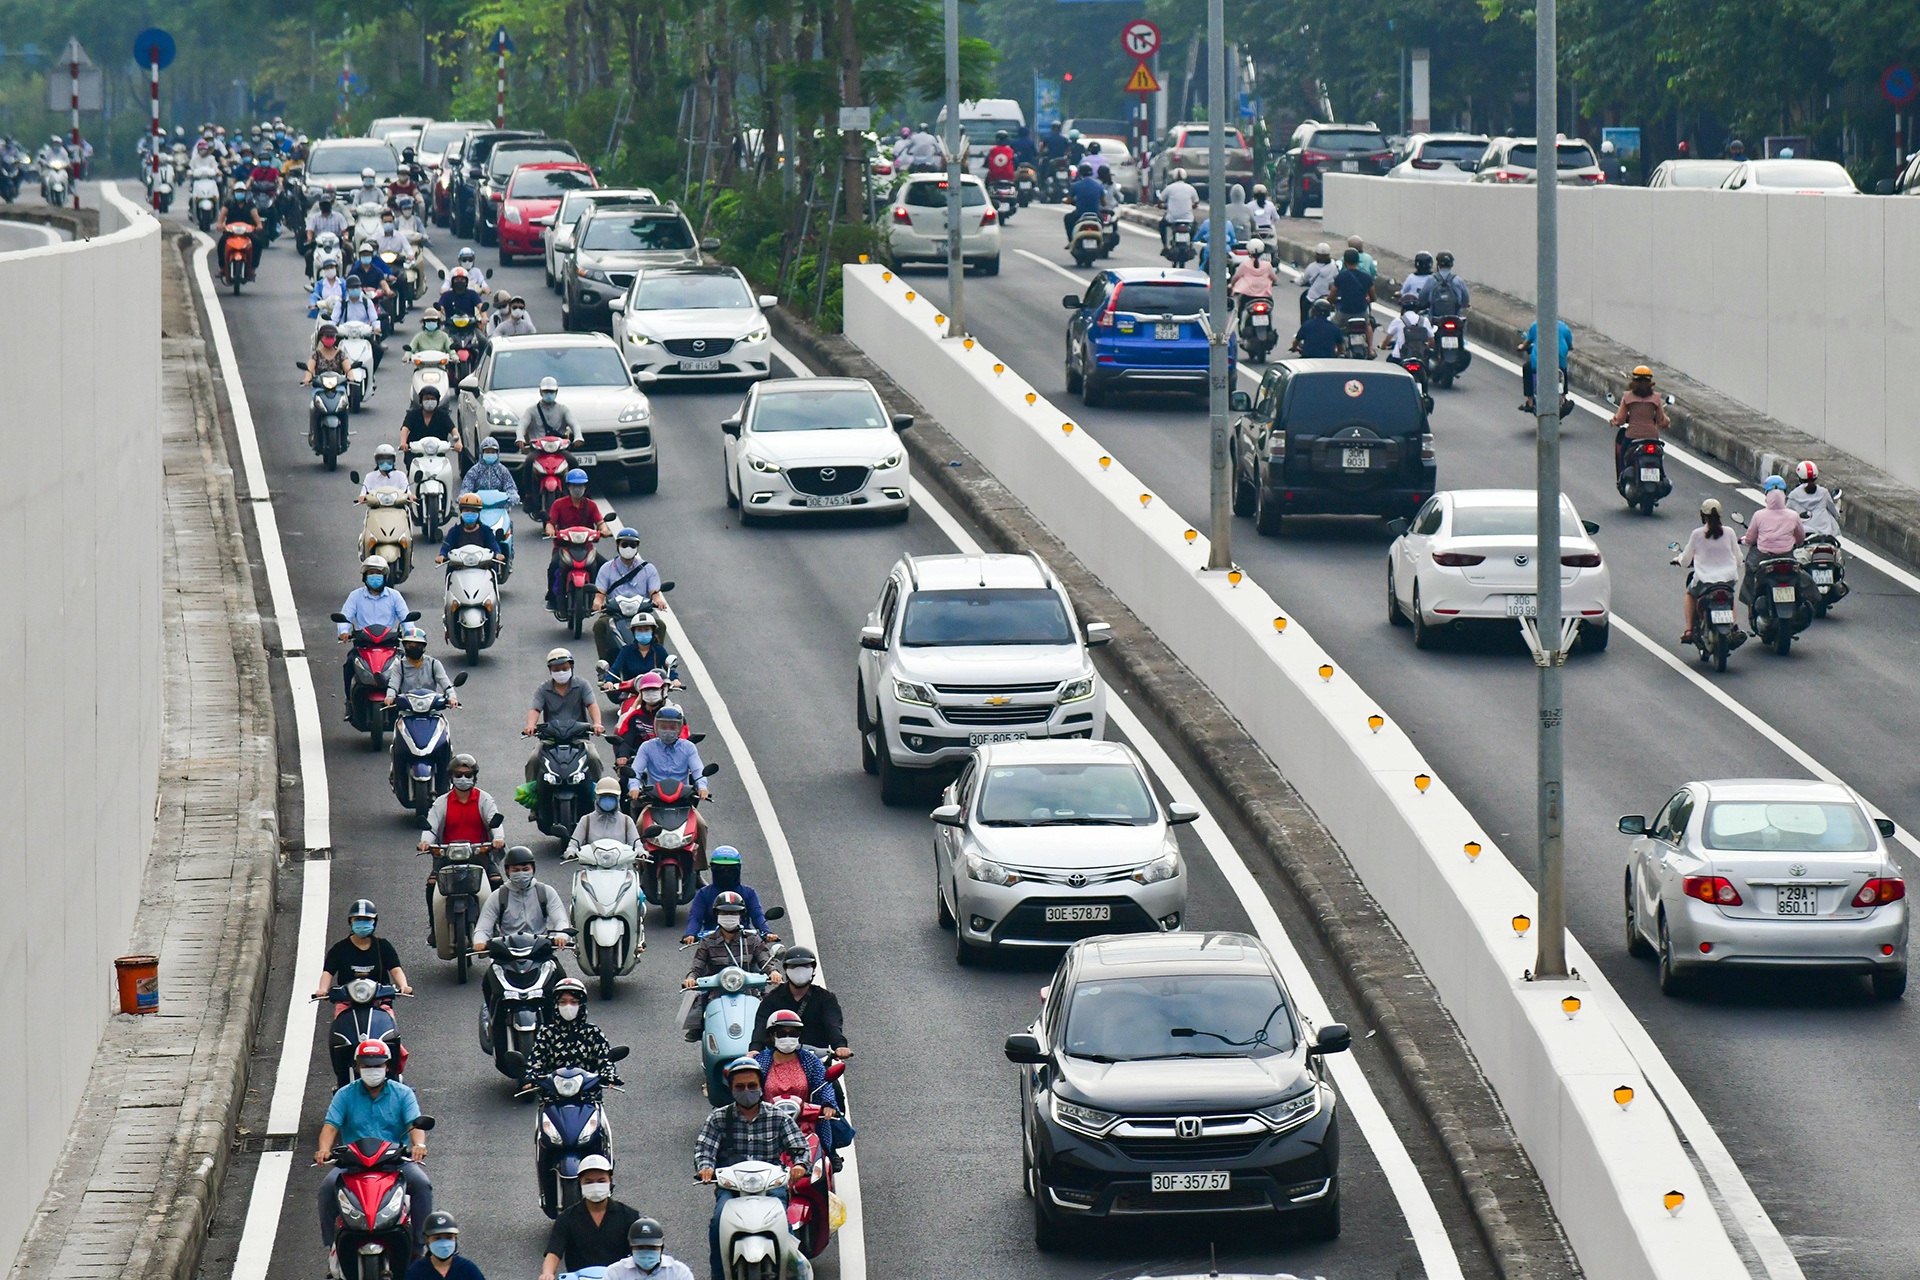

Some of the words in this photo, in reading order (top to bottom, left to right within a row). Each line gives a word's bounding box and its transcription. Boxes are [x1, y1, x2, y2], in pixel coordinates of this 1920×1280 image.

[1346, 458, 1366, 467] 9031
[1513, 595, 1531, 605] 30G
[1787, 888, 1808, 900] 29A
[1778, 901, 1816, 914] 850.11
[1047, 907, 1109, 921] 30E-578.73
[1153, 1174, 1228, 1190] 30F-357.57
